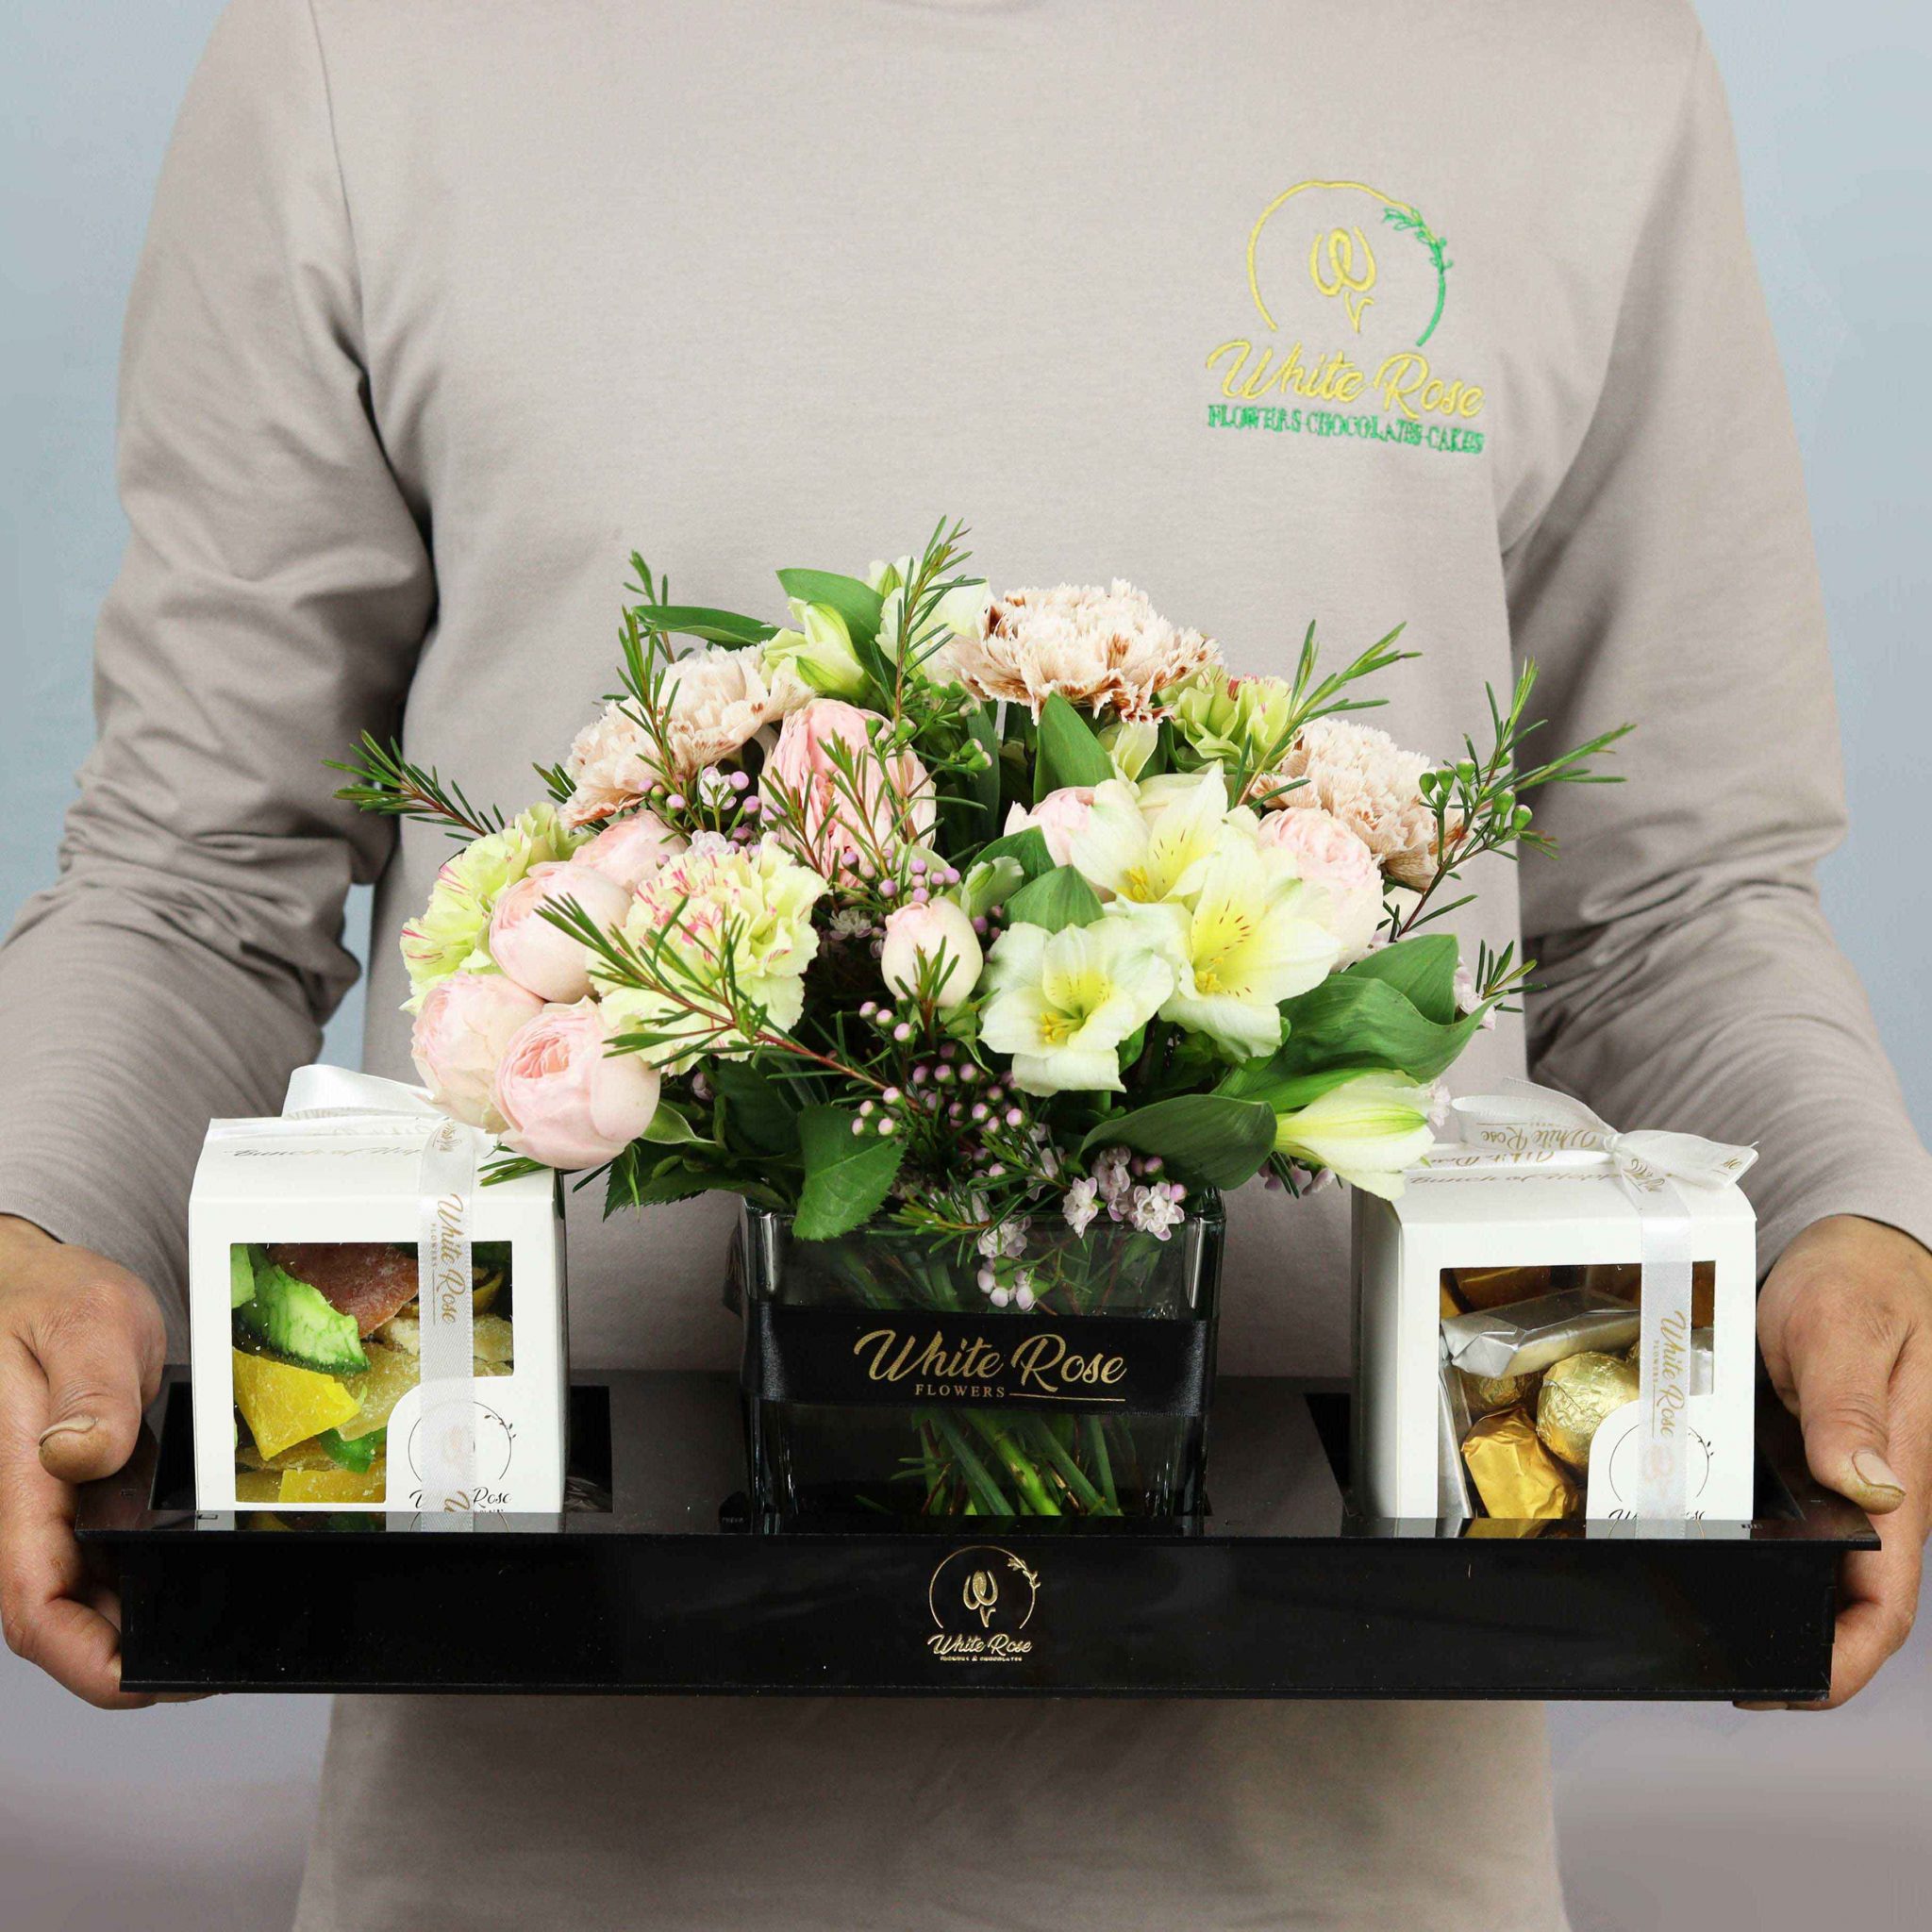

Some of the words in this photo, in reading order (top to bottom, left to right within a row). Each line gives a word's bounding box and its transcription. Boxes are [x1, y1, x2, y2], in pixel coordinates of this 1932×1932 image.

[1207, 339, 1366, 403] White
[1373, 352, 1485, 419] Rose
[1479, 1126, 1528, 1152] Rose
[437, 1193, 464, 1264] White
[436, 1269, 466, 1324] Rose
[853, 1329, 1004, 1382] White
[1010, 1333, 1127, 1392] Rose
[1660, 1310, 1687, 1379] White
[915, 1384, 1006, 1399] FLOWERS
[1656, 1384, 1686, 1438] Rose
[926, 1633, 986, 1656] White
[987, 1633, 1032, 1657] Rose
